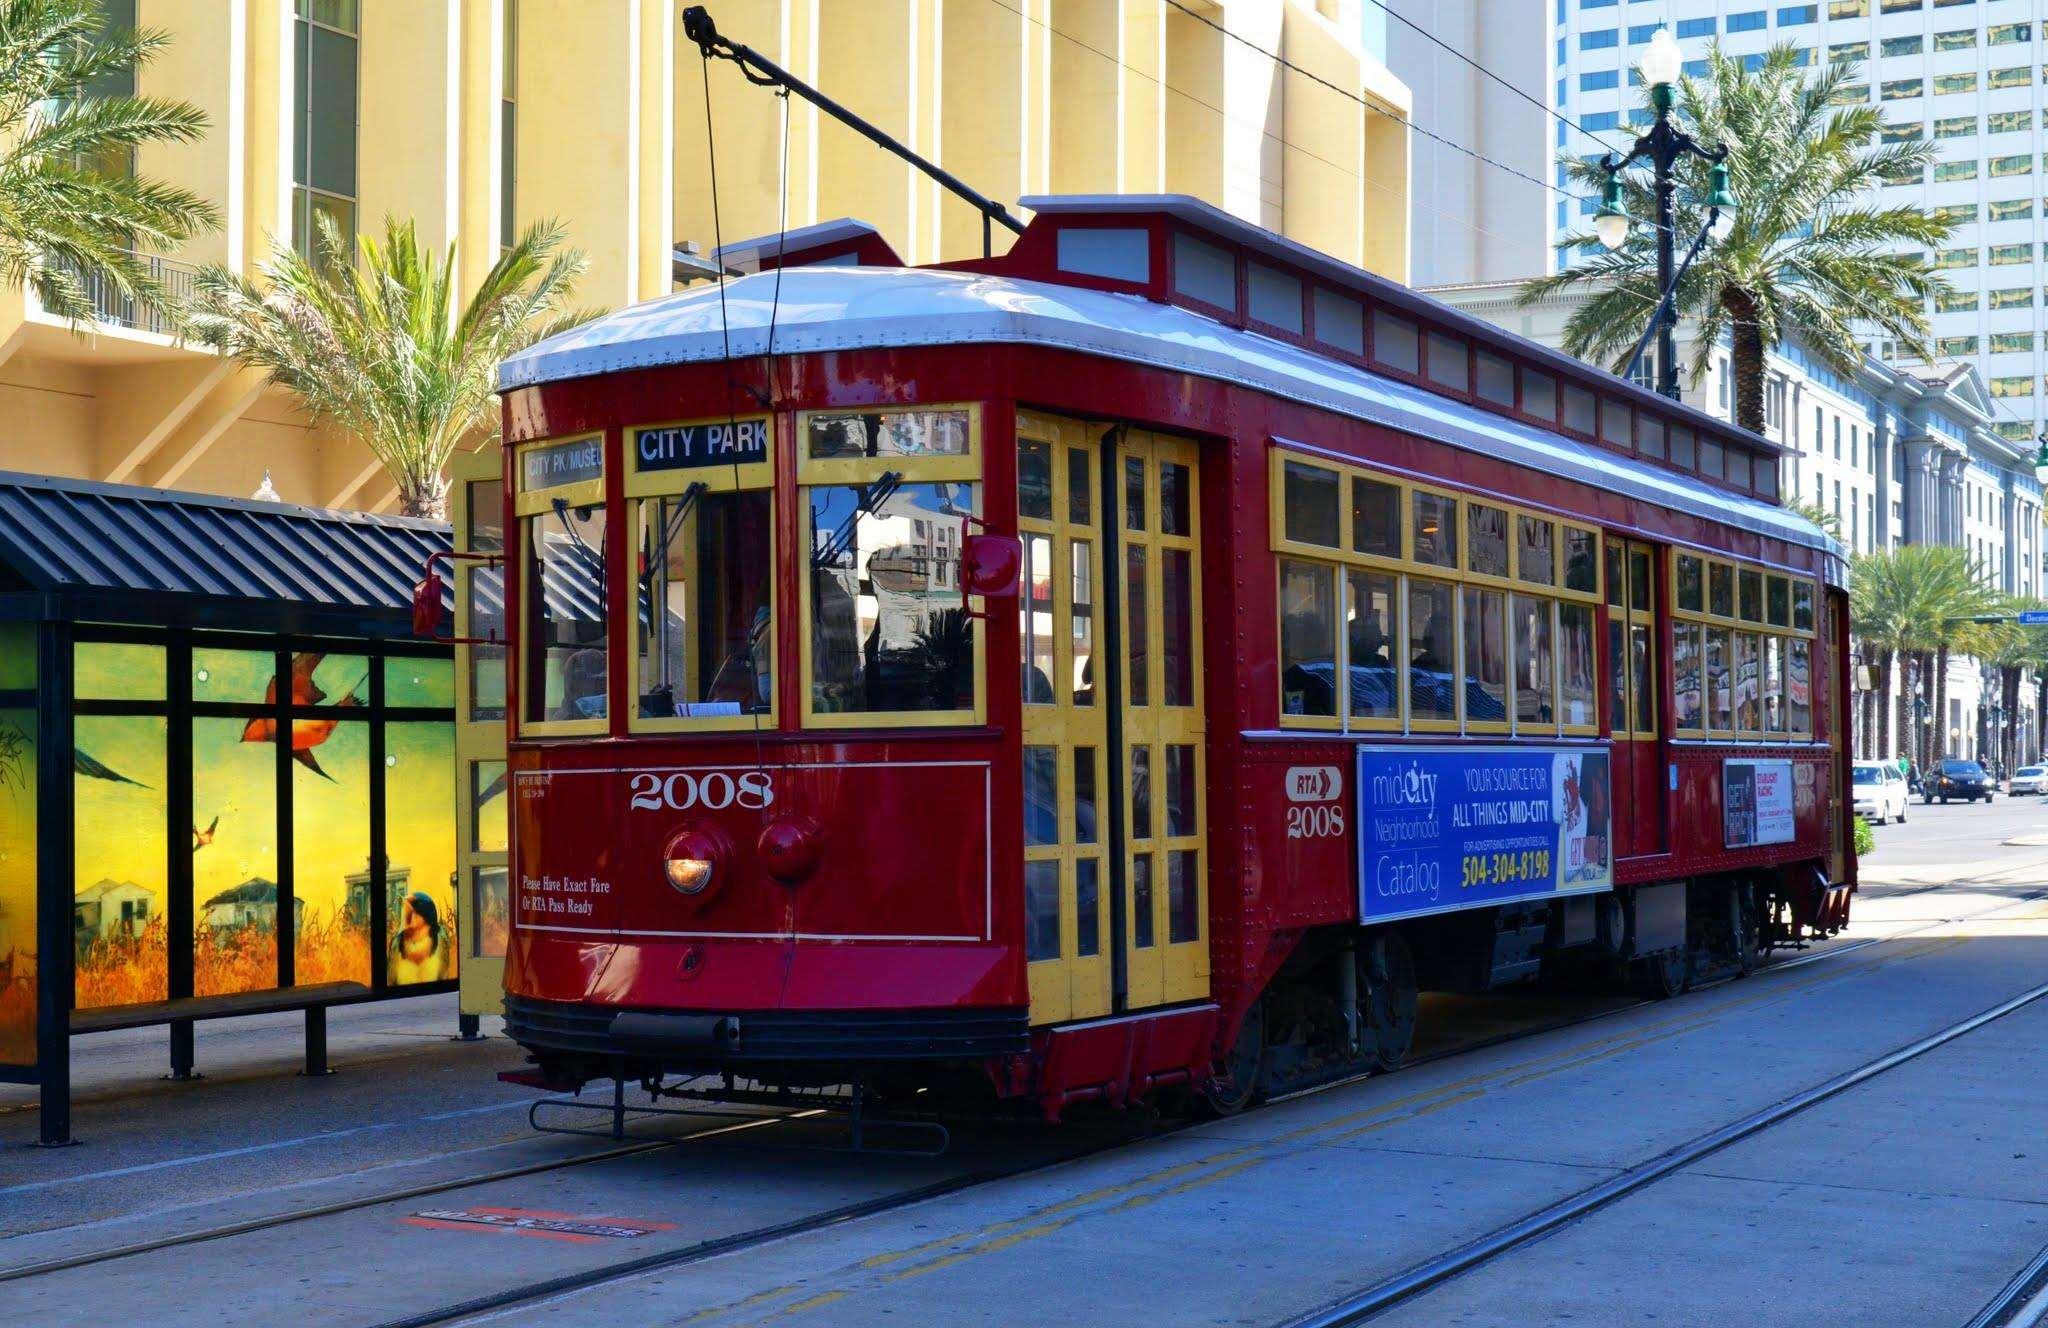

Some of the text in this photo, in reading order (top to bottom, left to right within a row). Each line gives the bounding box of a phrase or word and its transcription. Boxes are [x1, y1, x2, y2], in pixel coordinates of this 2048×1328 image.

[640, 422, 768, 461] CITY PARK
[530, 455, 551, 476] CITY
[630, 771, 774, 811] 2008
[1297, 775, 1317, 794] RTA
[1463, 767, 1548, 792] YOUR SOURCE FOR
[1287, 805, 1345, 838] 2008
[1453, 800, 1548, 827] ALL THINGS MID-CITY
[1375, 816, 1439, 848] Neighborhood
[1377, 850, 1440, 902] Catalog
[1462, 849, 1550, 888] 504-304-8198
[522, 875, 610, 893] Please Have Exact Fare
[522, 896, 593, 916] Or RTA Pass Ready
